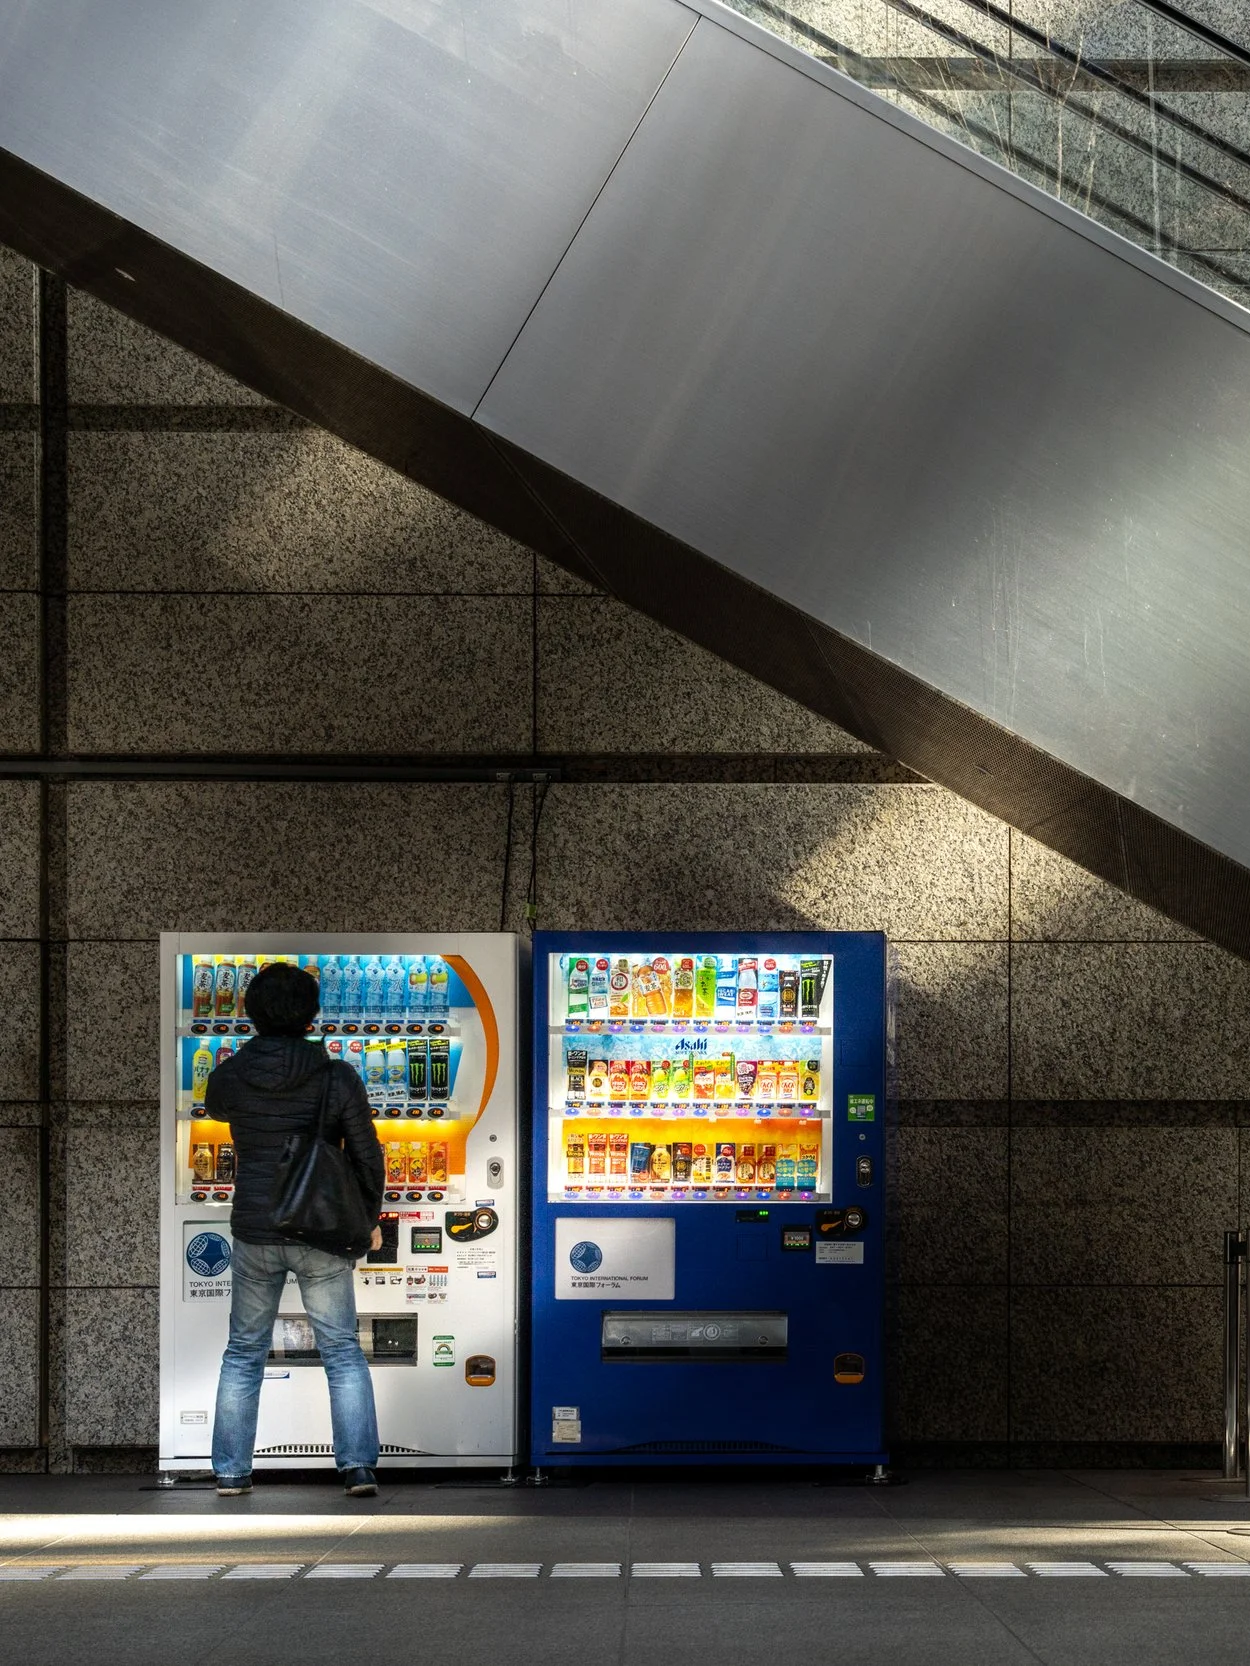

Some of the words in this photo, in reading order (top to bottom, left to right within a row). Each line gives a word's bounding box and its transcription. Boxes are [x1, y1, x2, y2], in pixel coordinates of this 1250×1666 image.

[675, 1038, 707, 1050] Asahi
[190, 1288, 232, 1298] 東京国際フ
